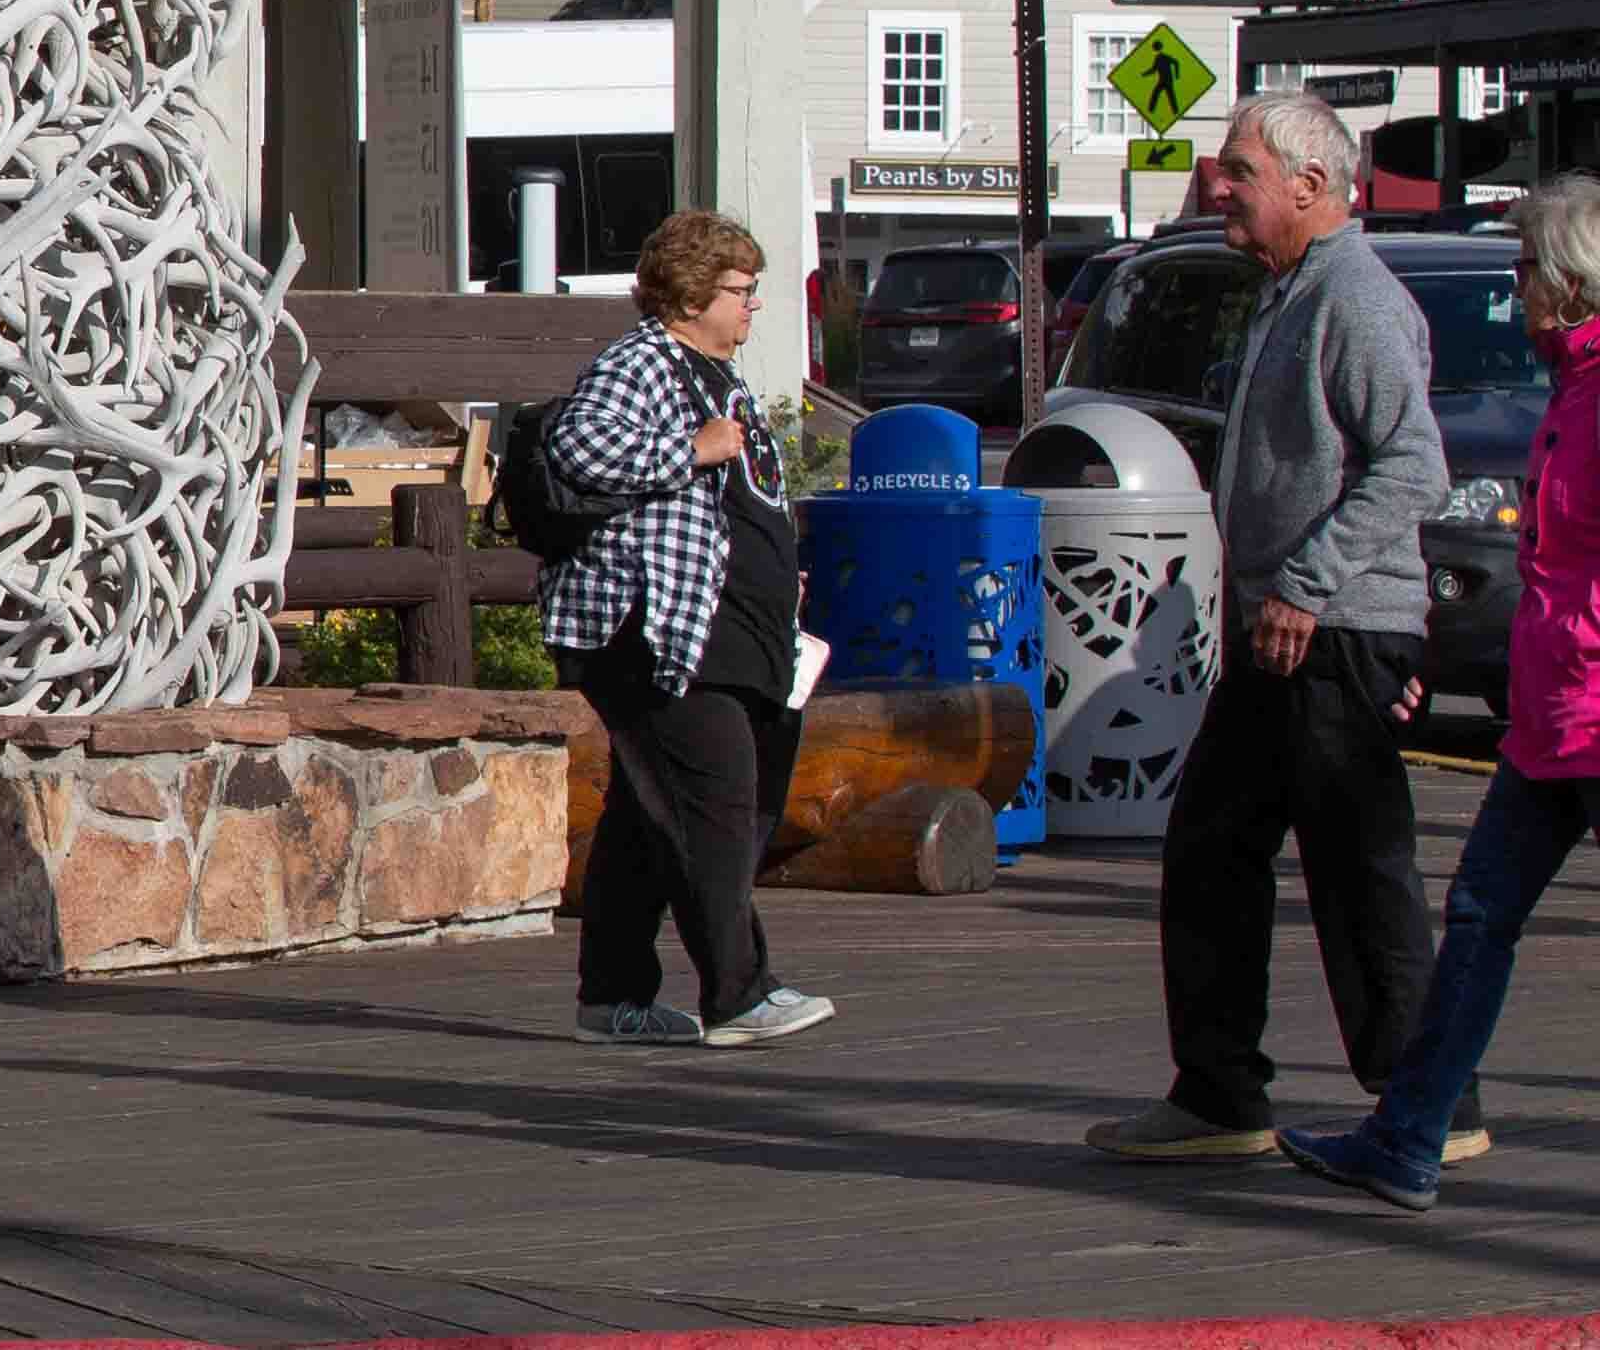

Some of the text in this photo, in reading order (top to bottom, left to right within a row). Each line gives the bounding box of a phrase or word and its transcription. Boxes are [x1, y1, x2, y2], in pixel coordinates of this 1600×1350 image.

[863, 166, 938, 186] Pearls
[946, 167, 975, 191] by
[873, 474, 951, 492] RECYCLE
